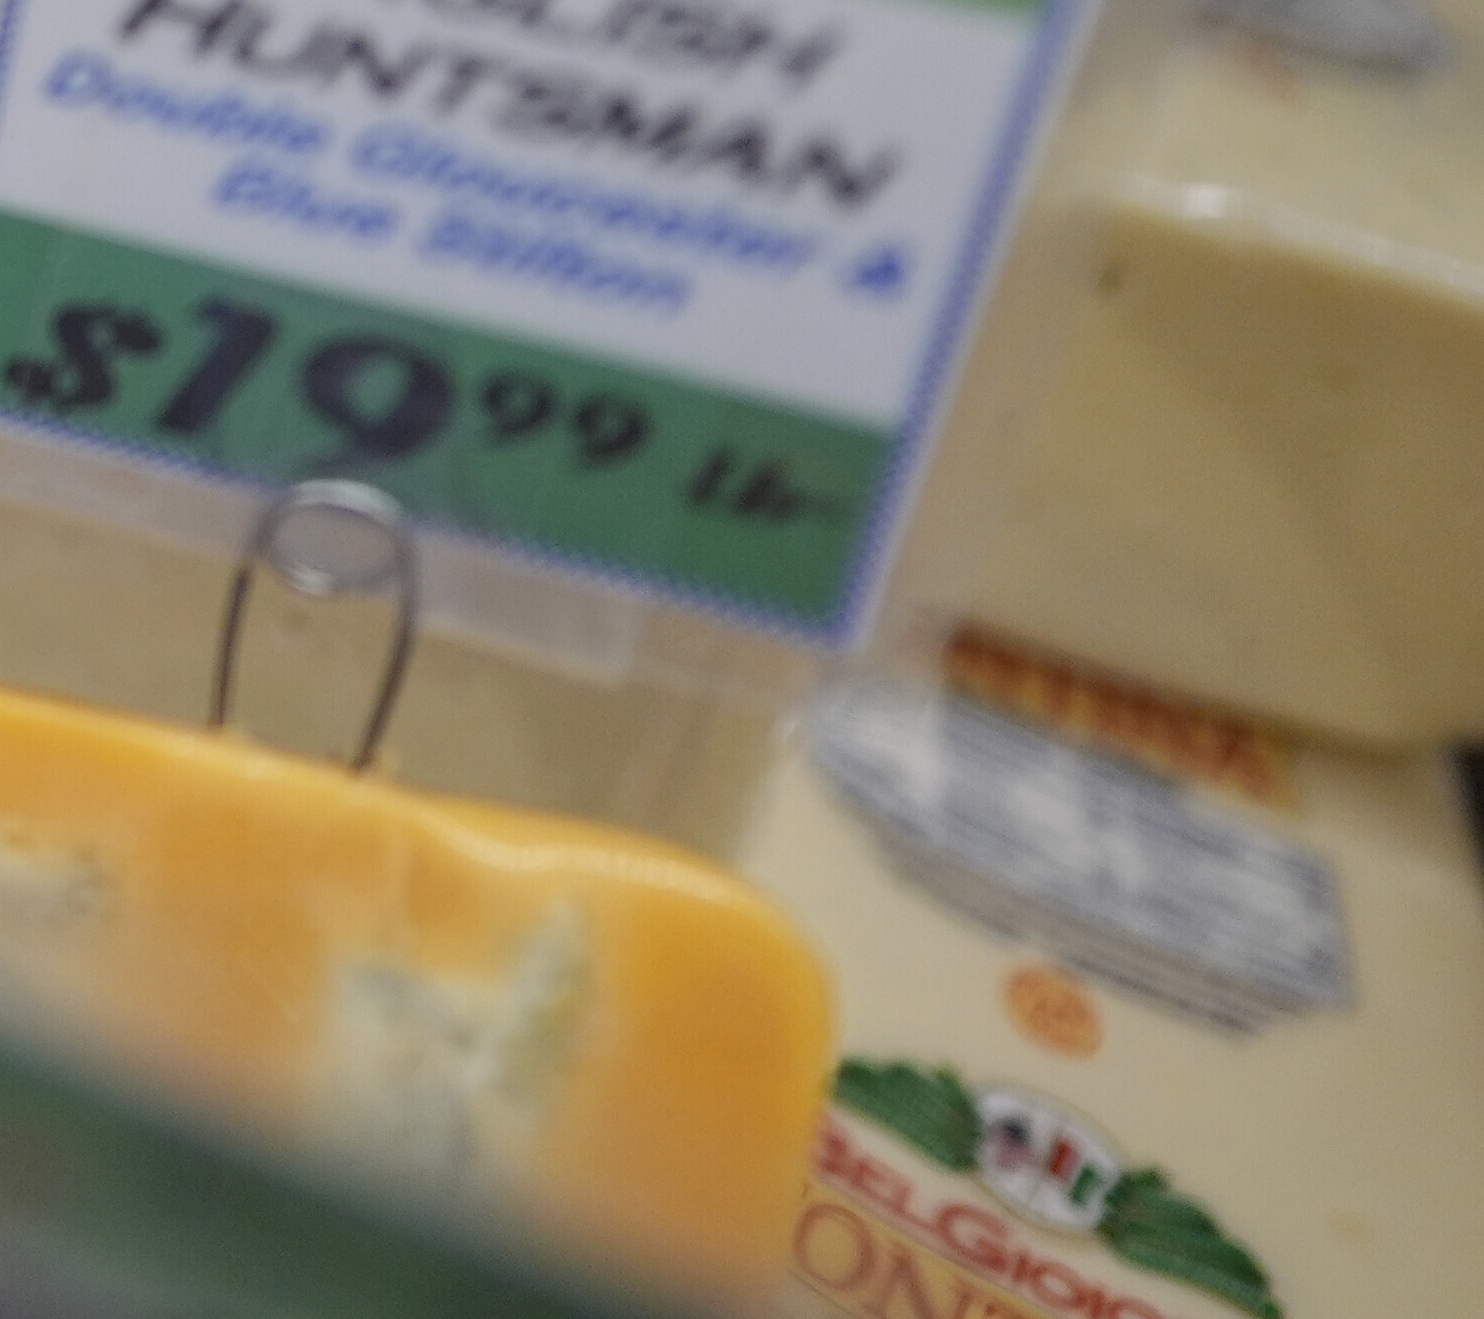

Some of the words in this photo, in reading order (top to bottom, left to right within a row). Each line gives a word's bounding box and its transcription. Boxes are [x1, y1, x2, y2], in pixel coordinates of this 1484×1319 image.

[43, 49, 331, 157] Double
[837, 237, 911, 303] &
[211, 161, 399, 243] Blue
[417, 206, 692, 314] Stilton
